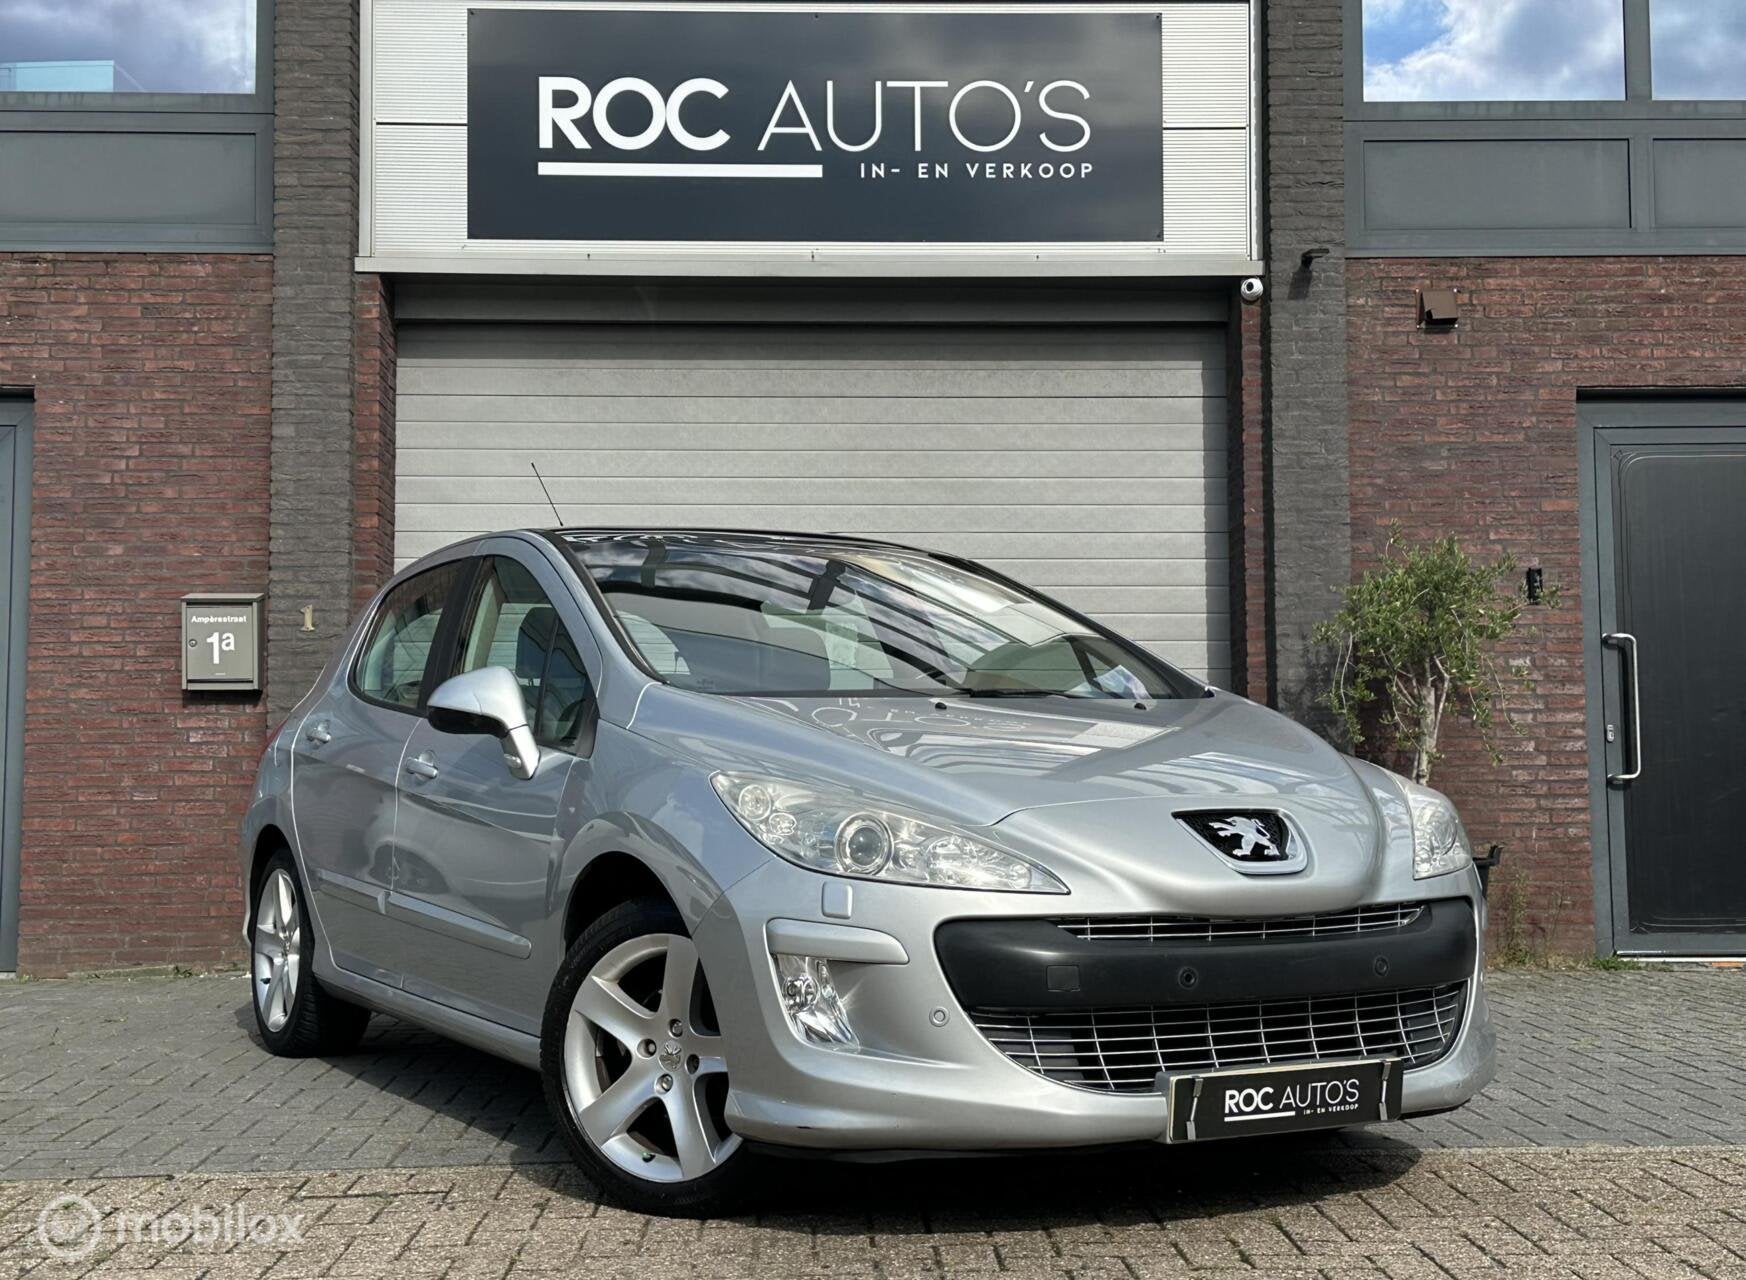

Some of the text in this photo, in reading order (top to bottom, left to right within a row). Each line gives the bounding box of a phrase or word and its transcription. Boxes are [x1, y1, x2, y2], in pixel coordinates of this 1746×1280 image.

[538, 76, 1092, 153] ROC AUTO'S
[860, 162, 1095, 179] IN- EN VERKOOP
[300, 604, 315, 631] 1
[206, 632, 235, 664] 1a
[1224, 1078, 1360, 1114] ROC AUTO'S
